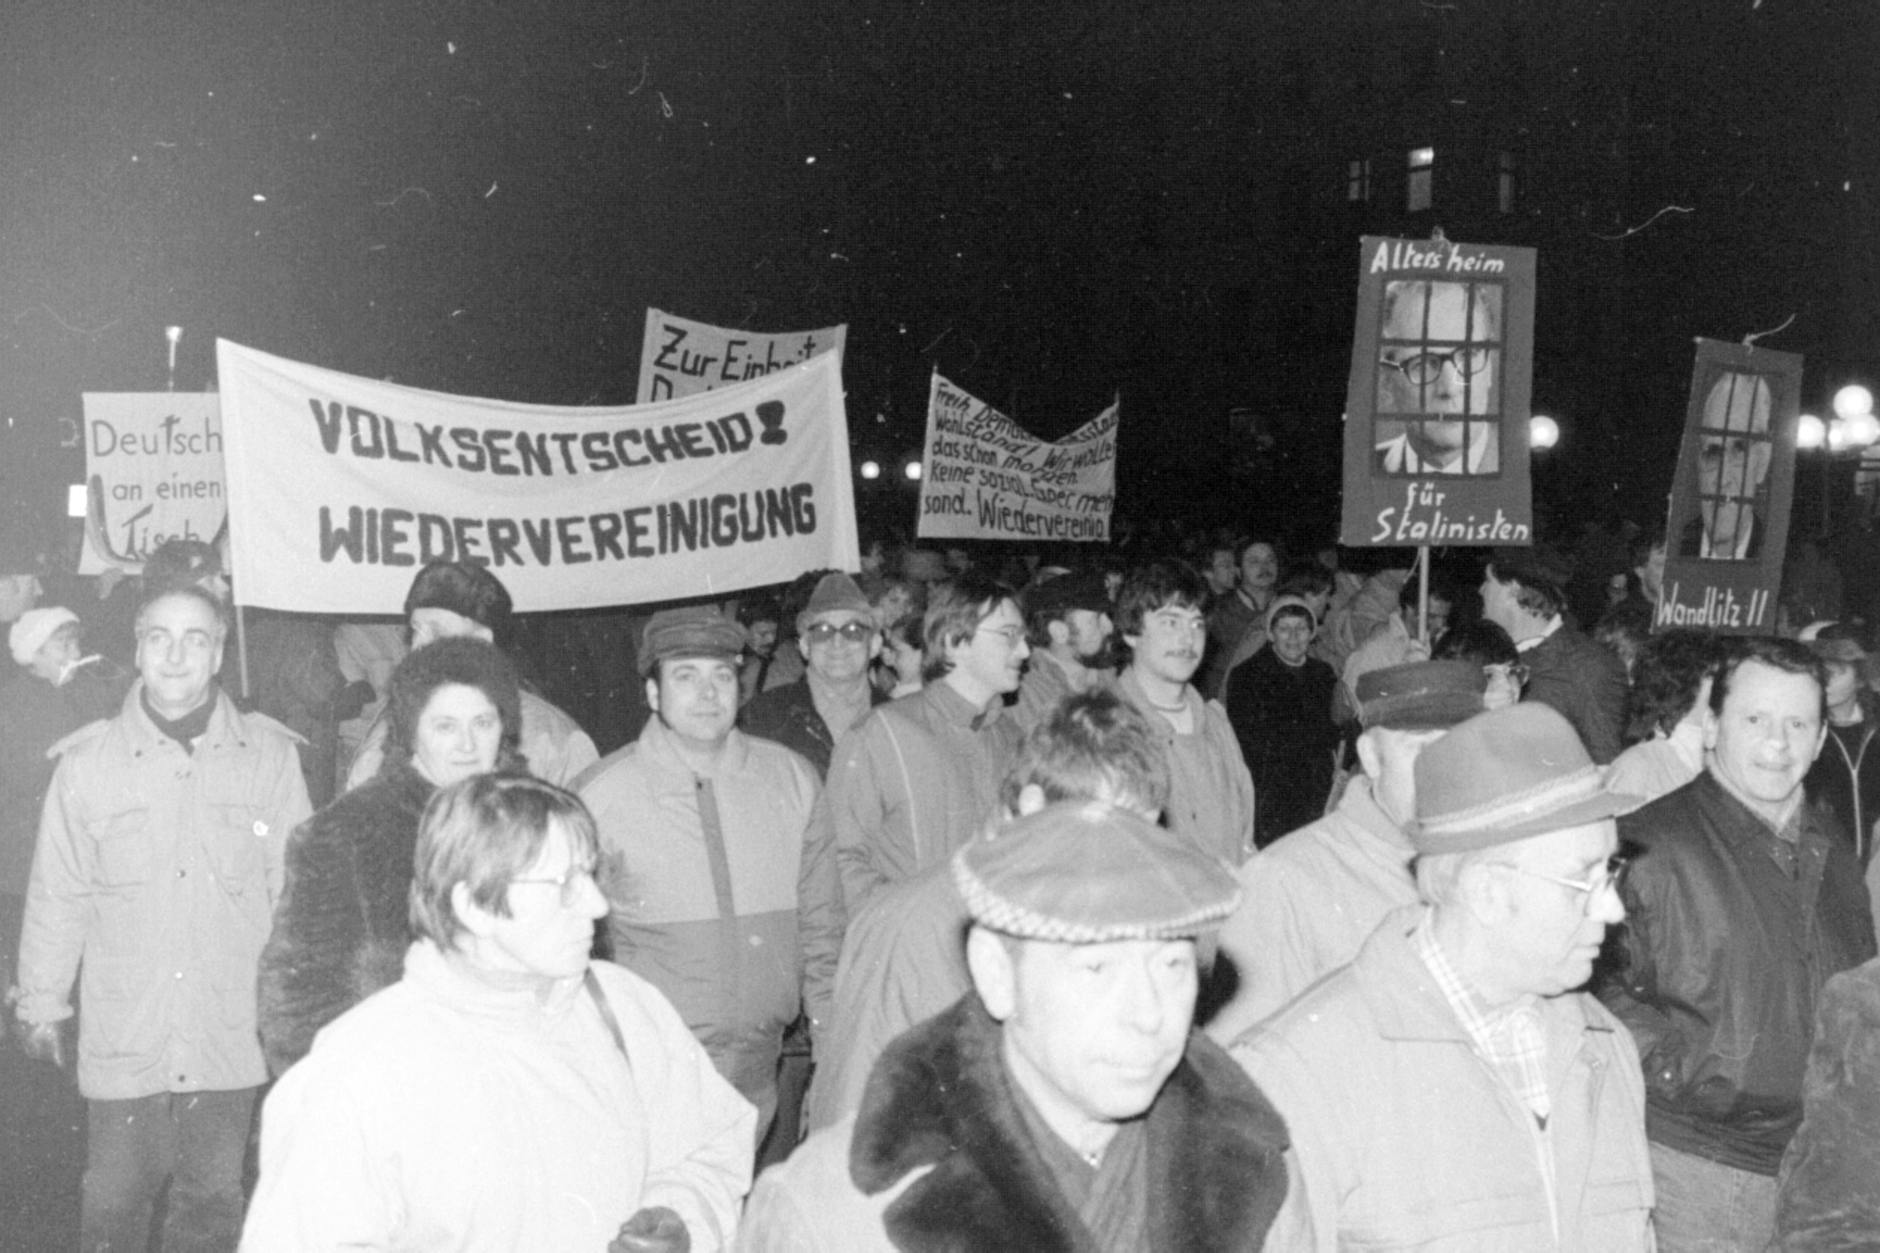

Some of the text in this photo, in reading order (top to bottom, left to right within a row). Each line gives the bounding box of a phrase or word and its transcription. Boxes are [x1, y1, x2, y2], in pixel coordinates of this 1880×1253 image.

[654, 324, 816, 381] Zur Einht
[308, 398, 788, 477] VOLKSENTSCHEID!
[931, 435, 960, 459] das
[112, 472, 221, 501] an einen
[1404, 482, 1446, 512] für
[319, 481, 817, 567] WIEDERVEREINIGUNG
[1371, 508, 1530, 543] Stalinisten
